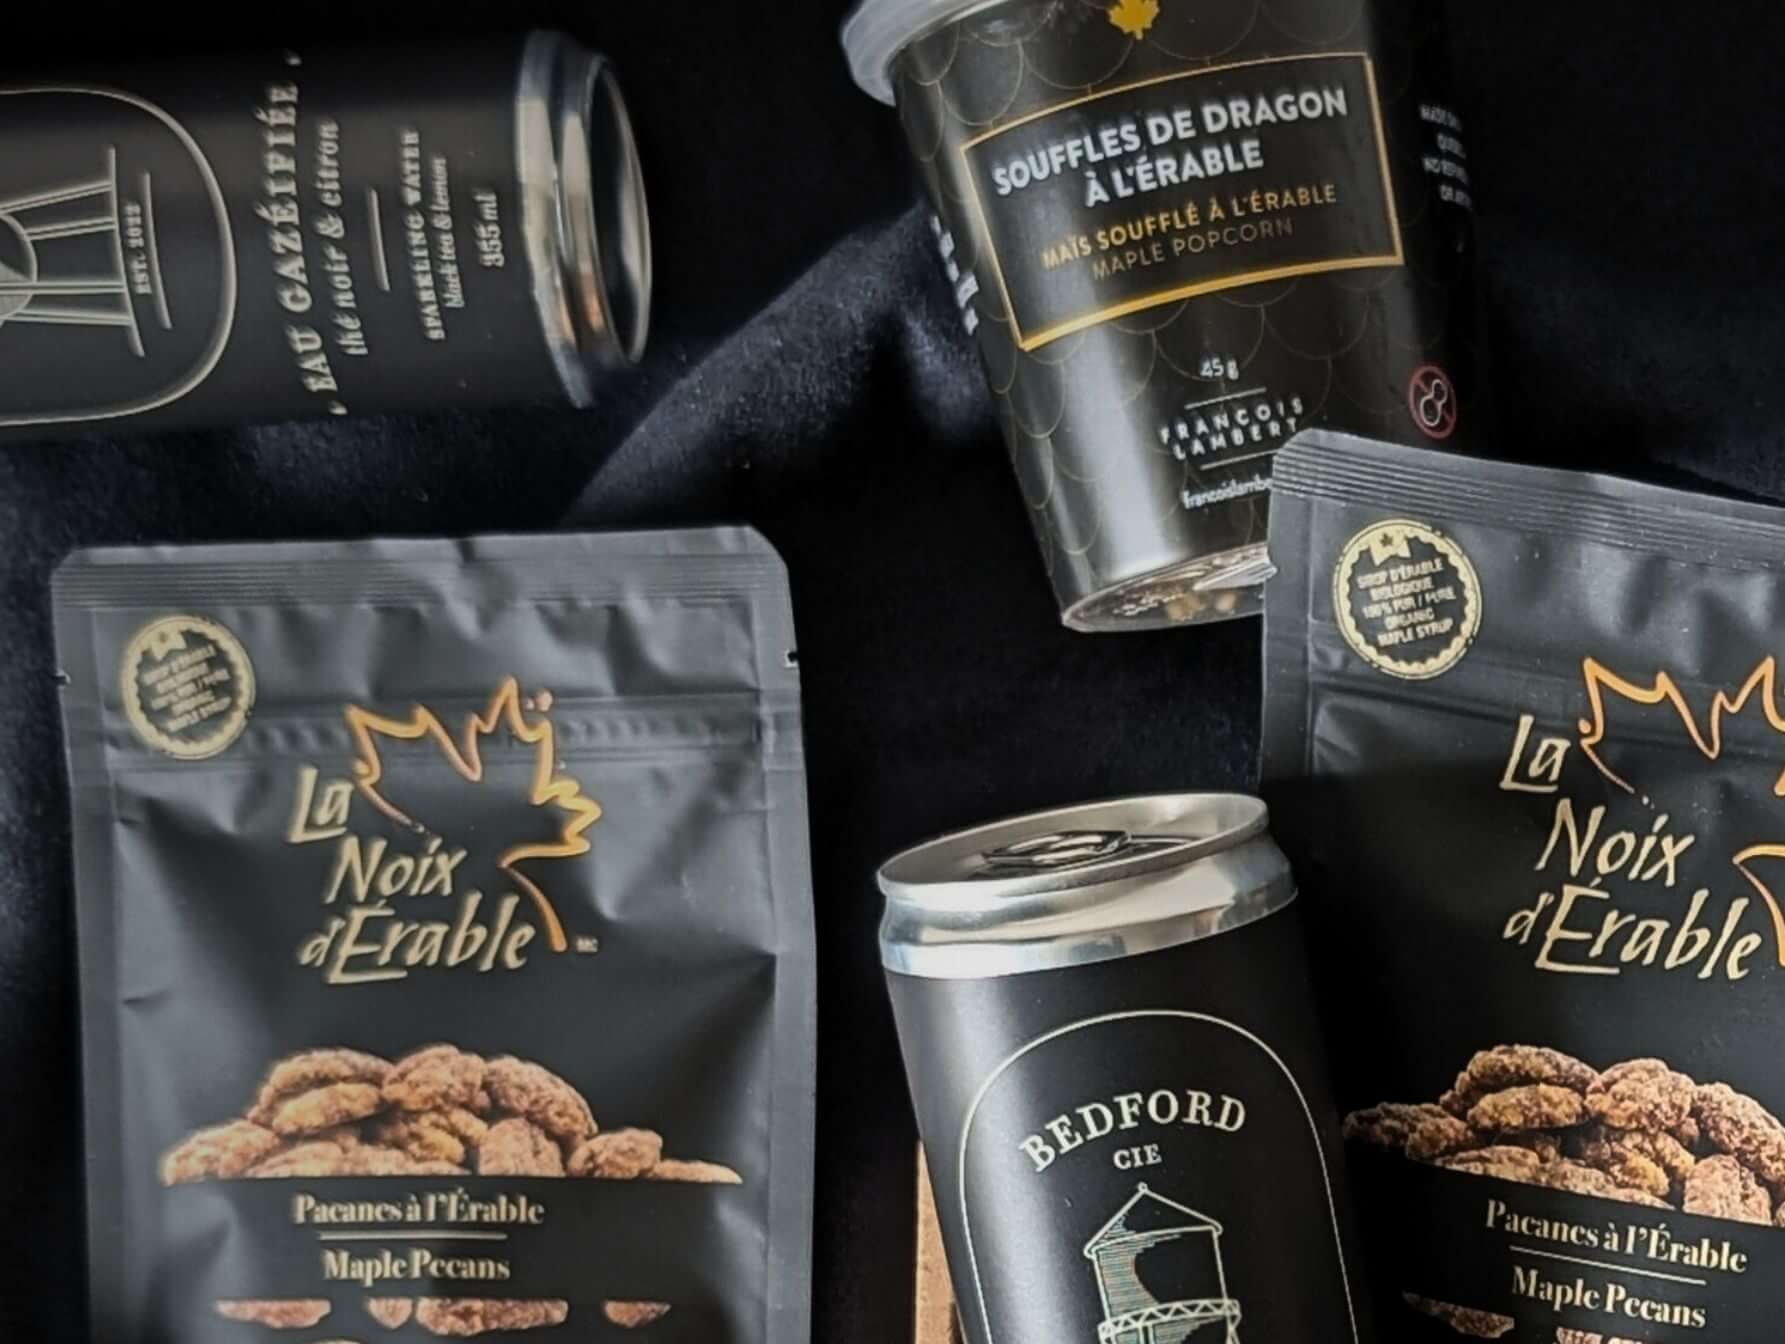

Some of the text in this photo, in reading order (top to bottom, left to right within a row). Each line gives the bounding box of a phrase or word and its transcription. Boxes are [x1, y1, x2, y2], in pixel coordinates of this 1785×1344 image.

[402, 131, 421, 206] WATER
[993, 88, 1348, 197] SOUFFLES DE DRAGON
[1084, 140, 1264, 208] À L'ÉRABLE
[253, 80, 338, 392] EAU GAZÉIFIÉE
[314, 118, 368, 355] thé noir & citron
[1041, 183, 1338, 271] MAÏS SOUFFLÉ À L'ÉRABLE
[1091, 218, 1295, 281] MAPLE POPCORN
[1159, 397, 1303, 445] FRANCOIS
[1172, 416, 1297, 461] LAMBERT
[1499, 714, 1571, 792] La
[289, 766, 354, 844] La
[1534, 798, 1697, 889] Noix
[326, 836, 466, 904] Noix
[298, 891, 536, 984] d'Érable
[1502, 876, 1763, 980] d'Érable
[1017, 1089, 1247, 1173] BEDFORD
[1113, 1143, 1164, 1171] CIE
[292, 1194, 404, 1224] Pacanes
[1484, 1198, 1749, 1275] Pacanes à l'Érable
[322, 1249, 511, 1286] Maple Pecans
[1510, 1264, 1708, 1329] Maple Pecans
